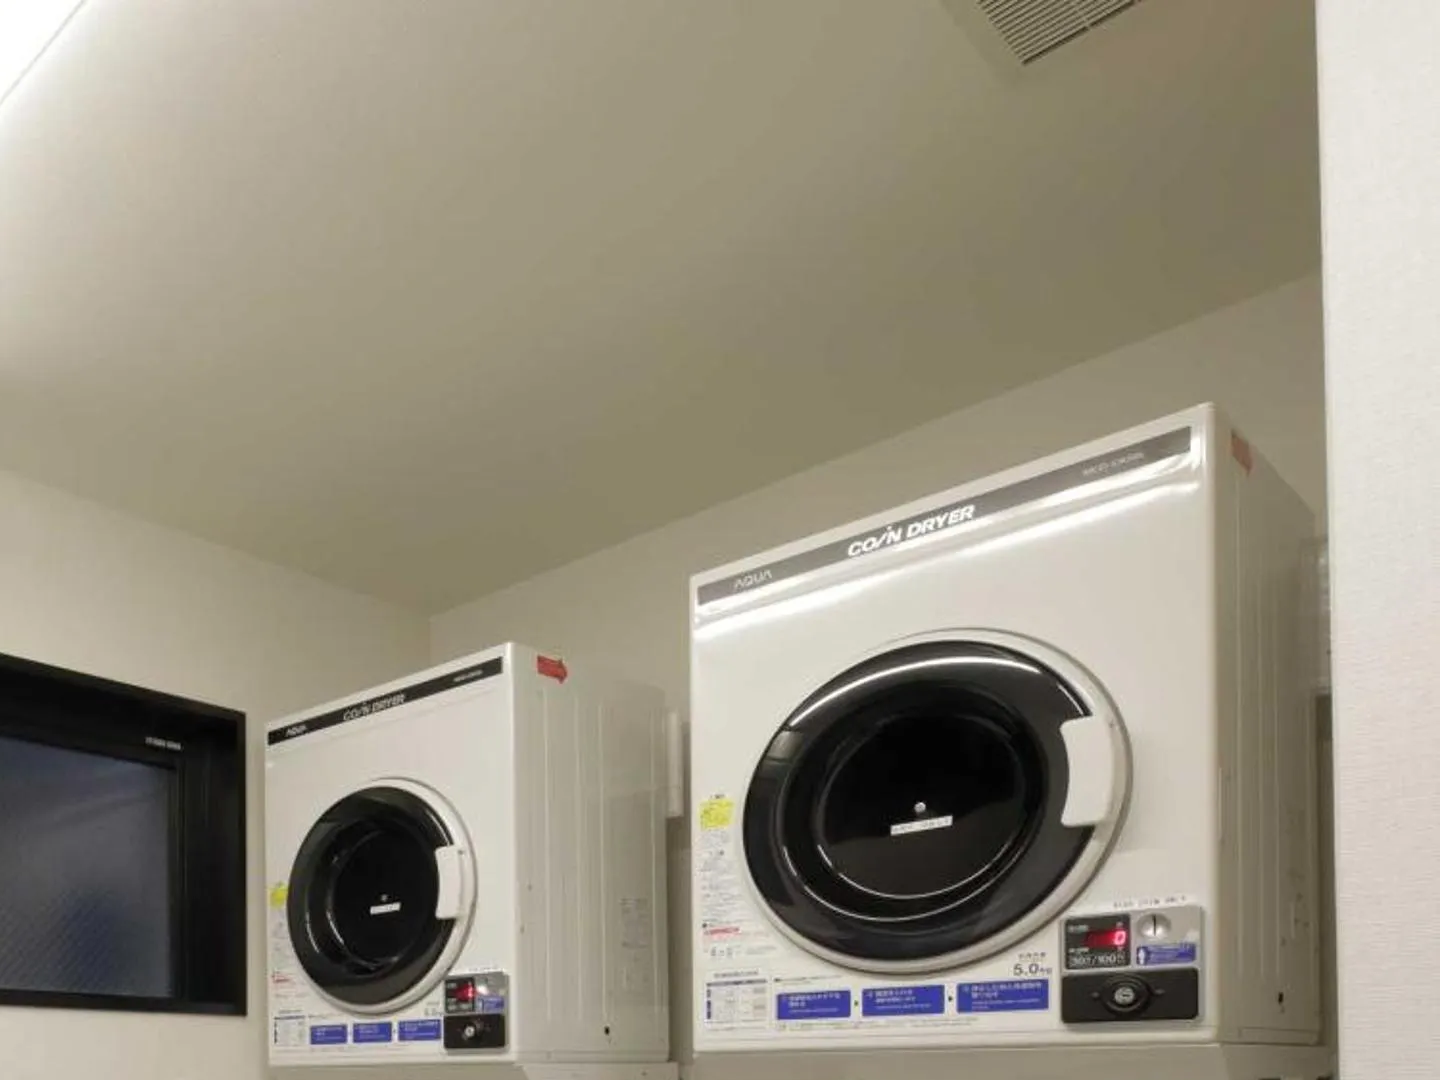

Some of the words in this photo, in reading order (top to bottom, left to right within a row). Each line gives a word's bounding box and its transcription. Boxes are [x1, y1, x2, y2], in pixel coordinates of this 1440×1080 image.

[907, 504, 976, 539] DRYER
[734, 568, 773, 590] AQUA
[1114, 931, 1126, 945] 0
